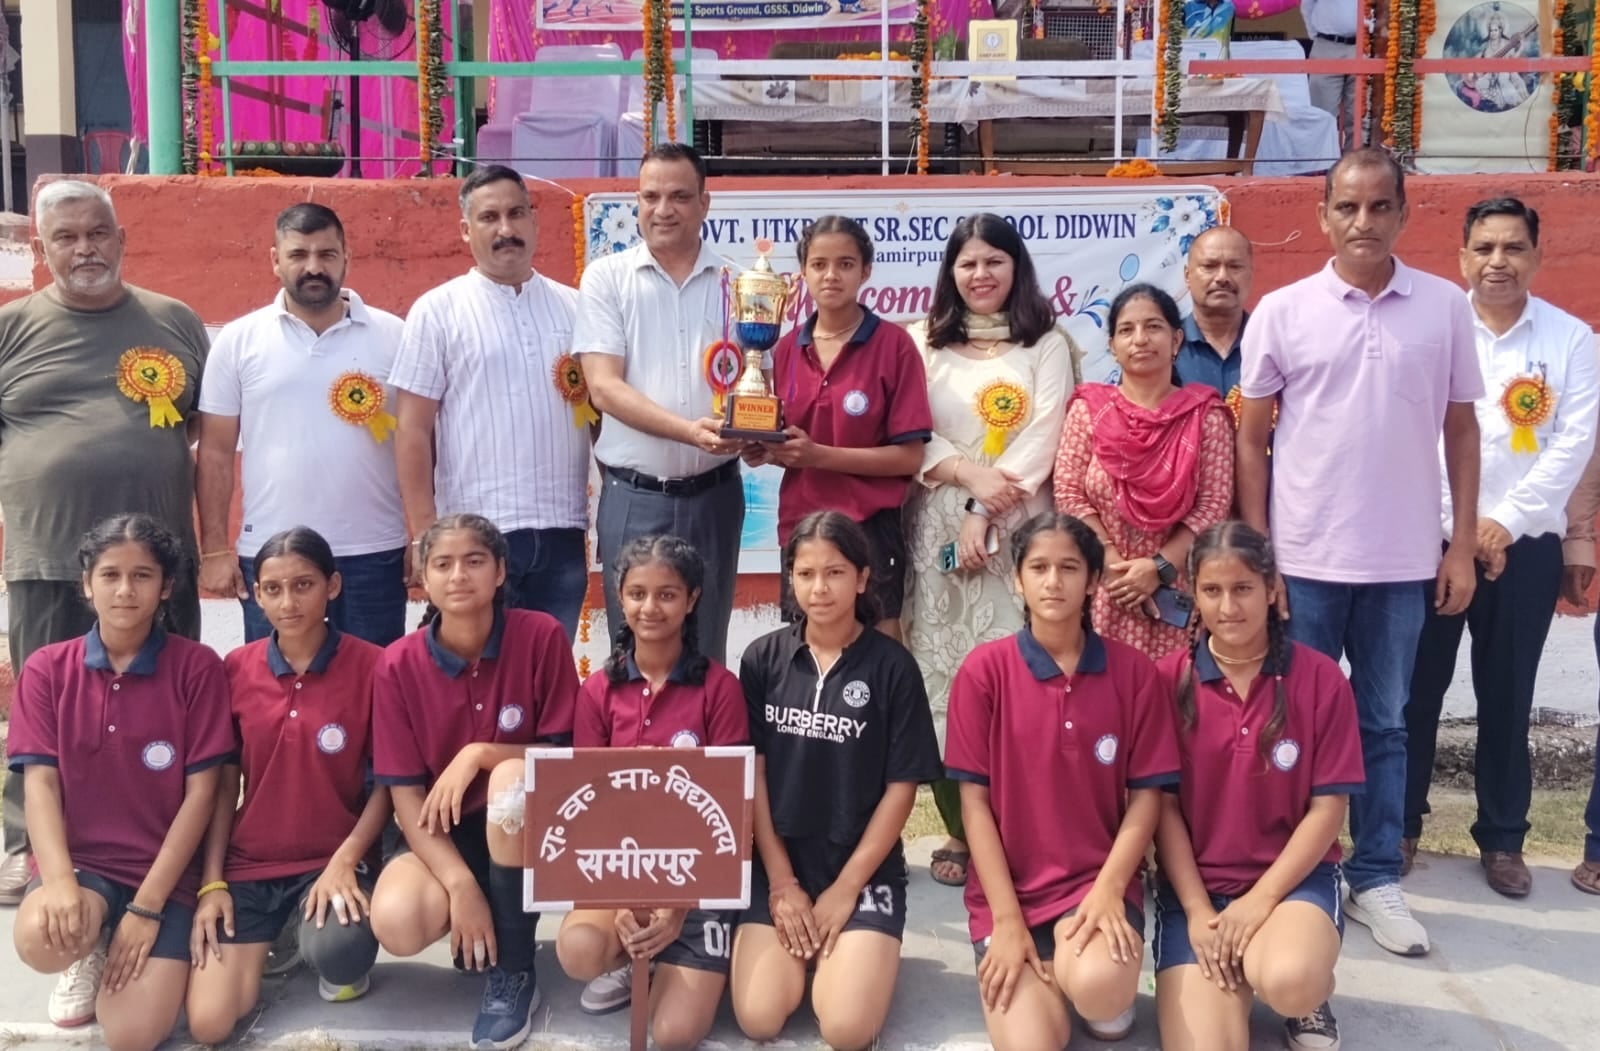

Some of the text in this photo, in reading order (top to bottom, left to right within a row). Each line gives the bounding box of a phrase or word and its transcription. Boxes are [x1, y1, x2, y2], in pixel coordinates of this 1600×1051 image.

[695, 6, 725, 17] Sports
[727, 5, 762, 16] Ground,
[764, 4, 791, 15] GSSS,
[793, 3, 823, 13] Didwin
[1055, 213, 1137, 239] DIDWIN
[872, 247, 944, 266] amirpur
[738, 402, 774, 414] WINNER
[765, 704, 867, 739] BURBERRY
[807, 729, 845, 743] ENGLAND
[664, 765, 737, 856] विद्यालय
[575, 836, 702, 886] समीरपुर
[859, 885, 894, 916] 13
